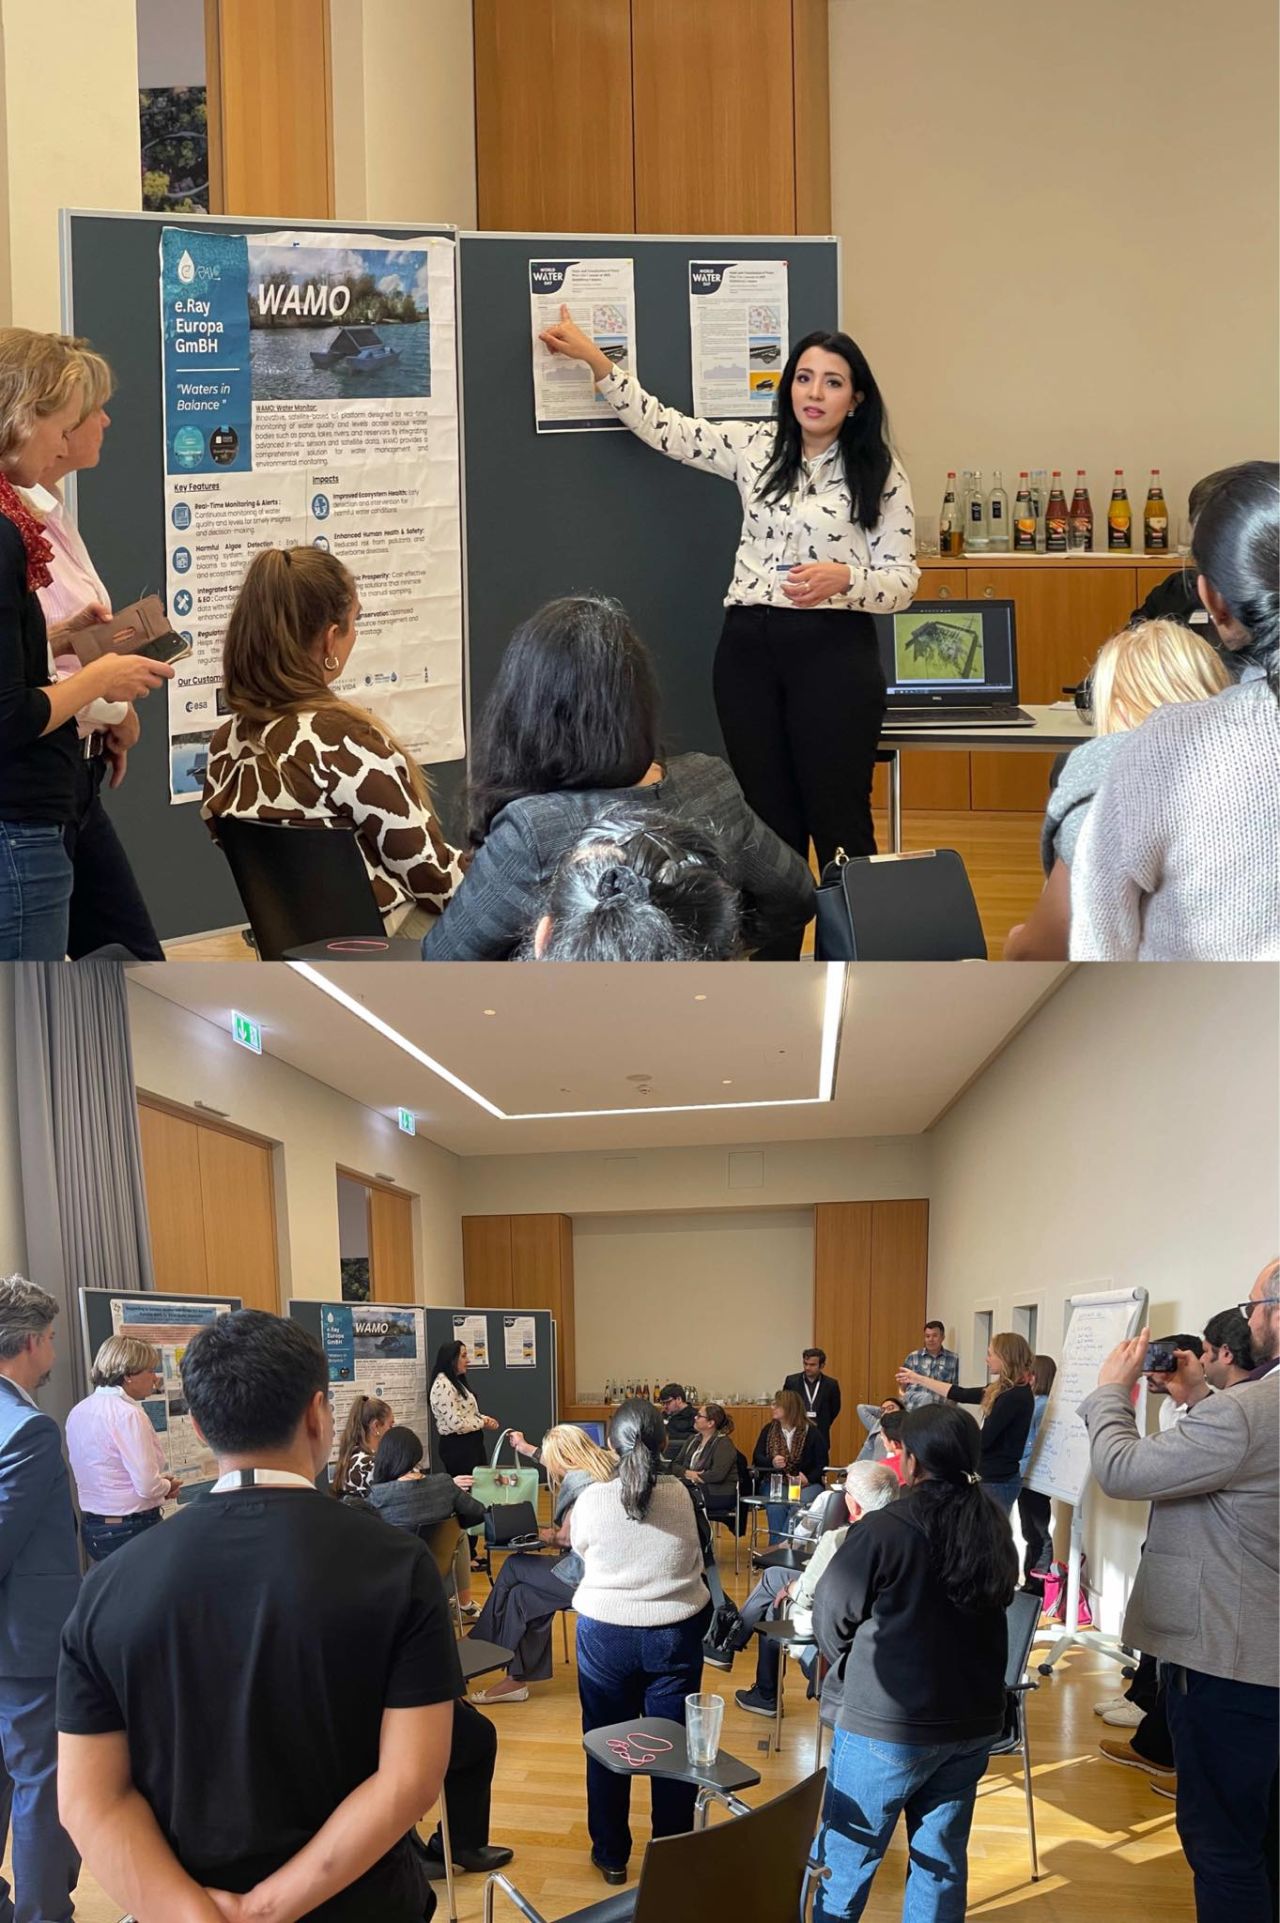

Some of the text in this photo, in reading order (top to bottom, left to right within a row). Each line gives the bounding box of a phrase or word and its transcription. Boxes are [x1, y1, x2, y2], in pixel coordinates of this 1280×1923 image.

[533, 272, 563, 281] WATER
[692, 273, 721, 282] WATER
[256, 283, 351, 316] WAMO
[174, 298, 211, 317] e.Ray
[175, 317, 225, 336] Europa
[175, 337, 218, 353] GmBH
[220, 382, 231, 394] in
[313, 476, 339, 484] Impacts
[174, 483, 220, 493] Key Features
[225, 500, 255, 508] Monitoring
[228, 509, 257, 517] monitoring
[225, 543, 241, 551] Algae
[197, 586, 227, 595] Integrated
[178, 678, 191, 687] Our
[355, 1322, 390, 1334] WAMO
